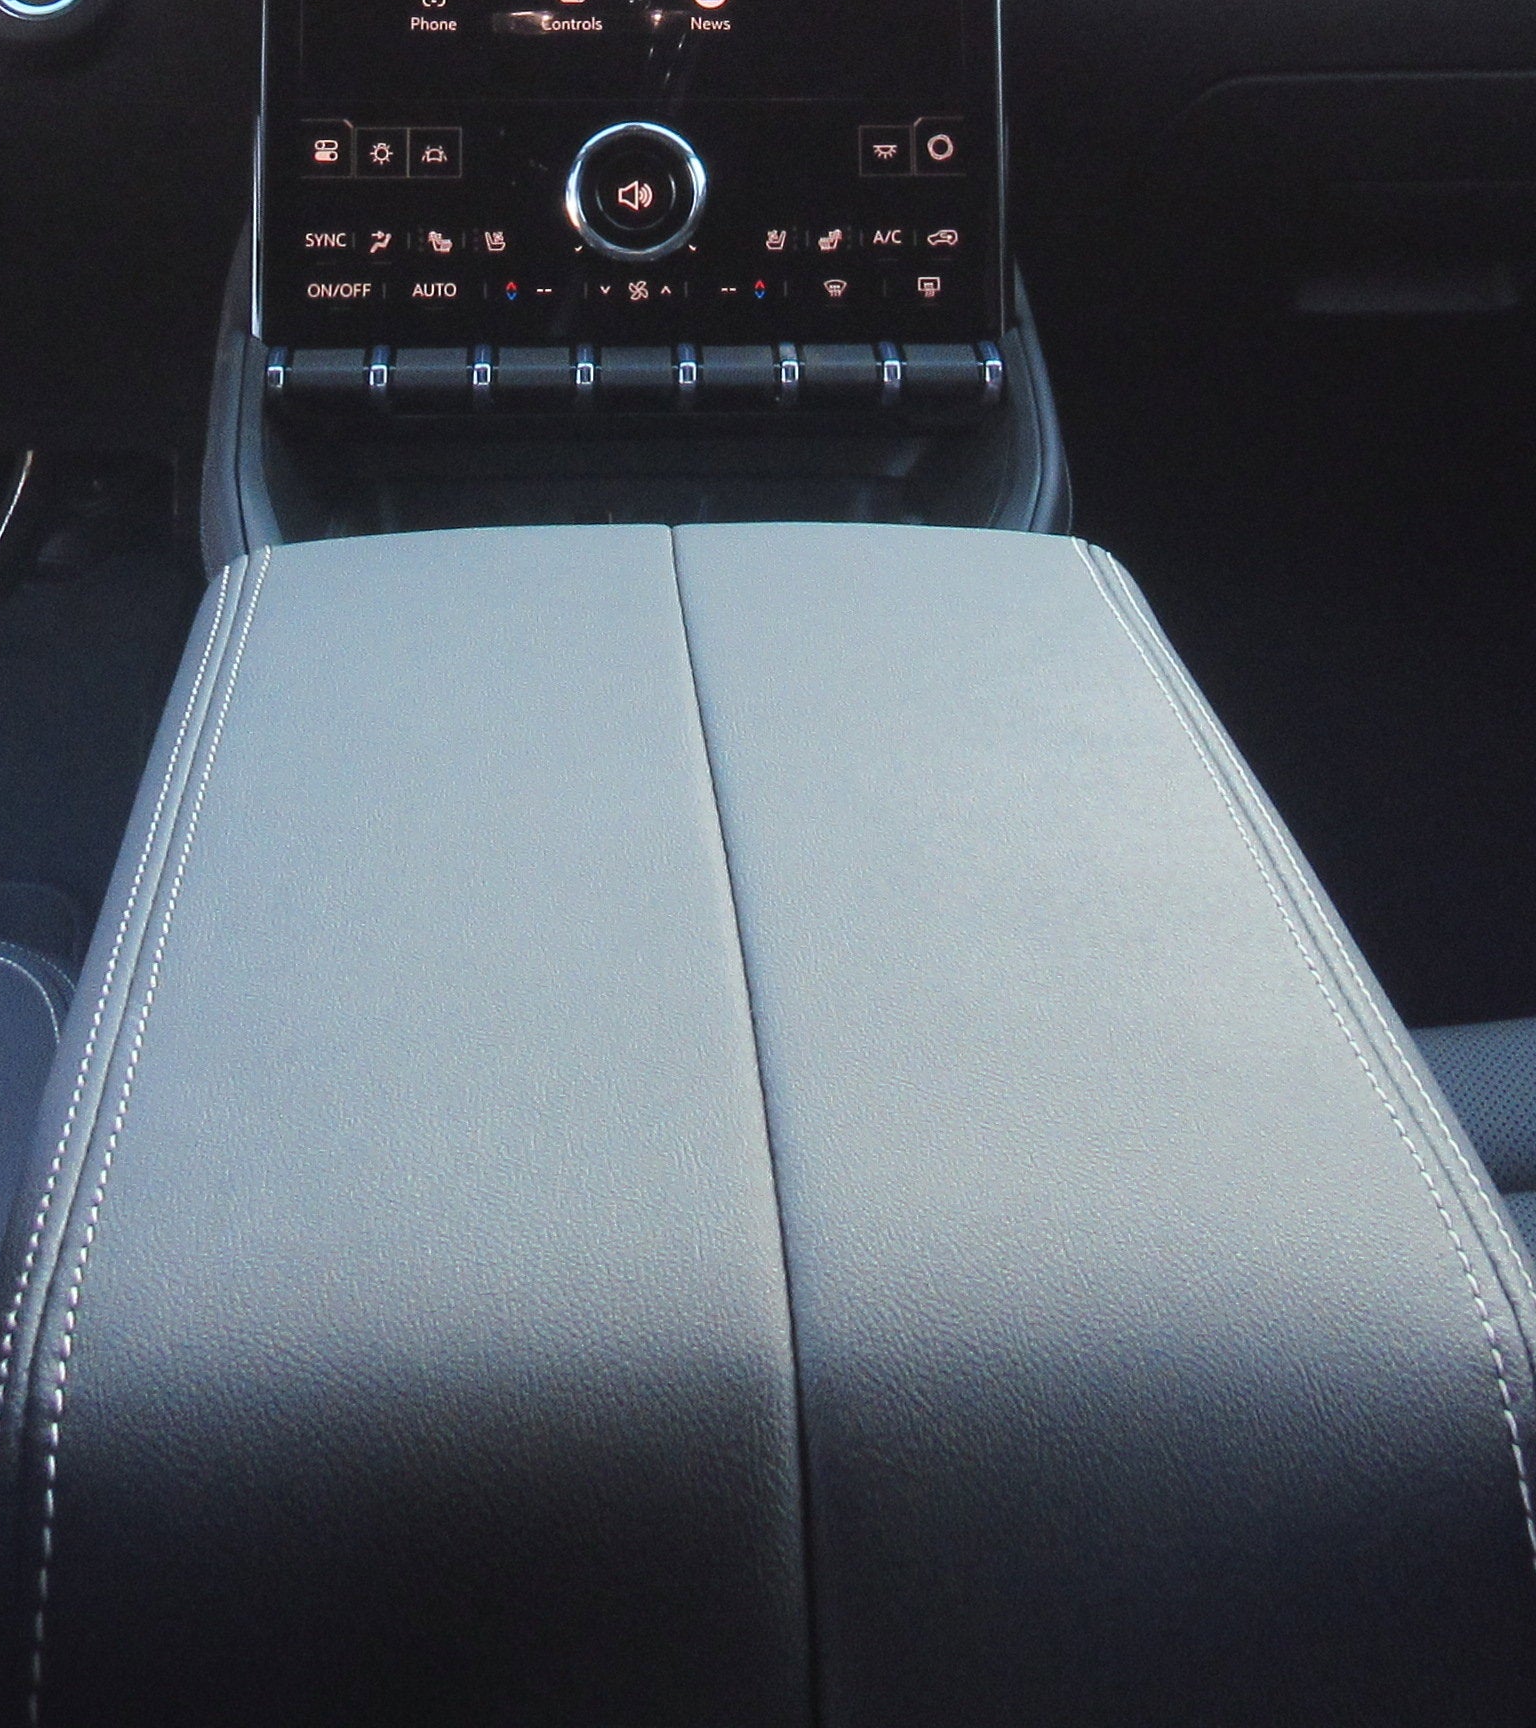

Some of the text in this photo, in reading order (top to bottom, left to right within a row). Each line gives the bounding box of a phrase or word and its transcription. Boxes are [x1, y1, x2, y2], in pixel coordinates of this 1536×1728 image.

[410, 16, 457, 32] Phone
[541, 16, 603, 32] Controls
[690, 16, 731, 31] News
[305, 233, 347, 248] SYNC
[873, 230, 902, 245] A/C
[307, 282, 372, 298] ON/OFF
[412, 282, 458, 298] AUTO
